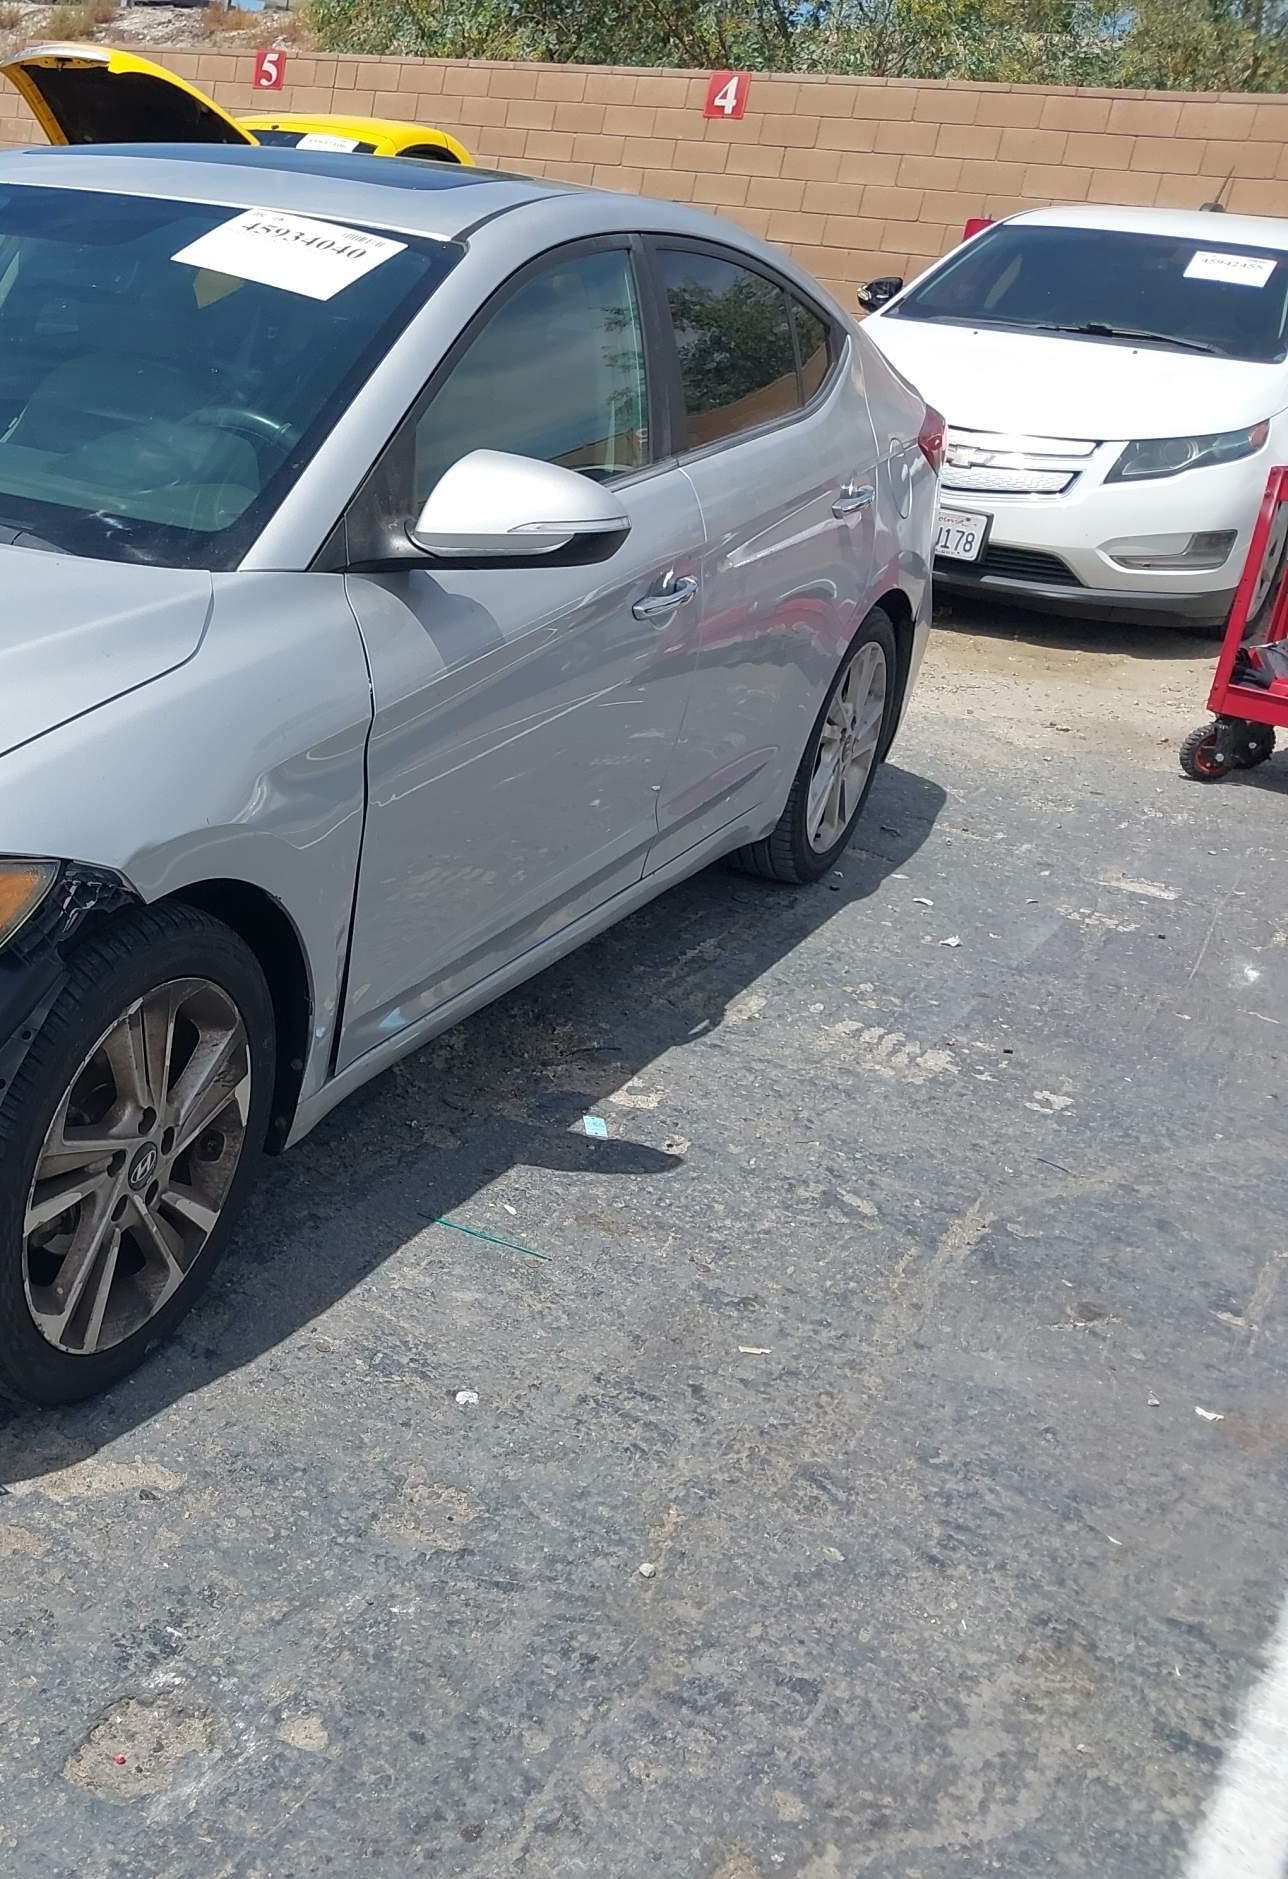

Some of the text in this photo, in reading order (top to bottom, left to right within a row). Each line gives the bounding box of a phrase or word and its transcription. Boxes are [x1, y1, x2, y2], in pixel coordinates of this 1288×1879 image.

[259, 53, 280, 87] 5
[713, 76, 739, 115] 4
[242, 222, 367, 259] 45934040
